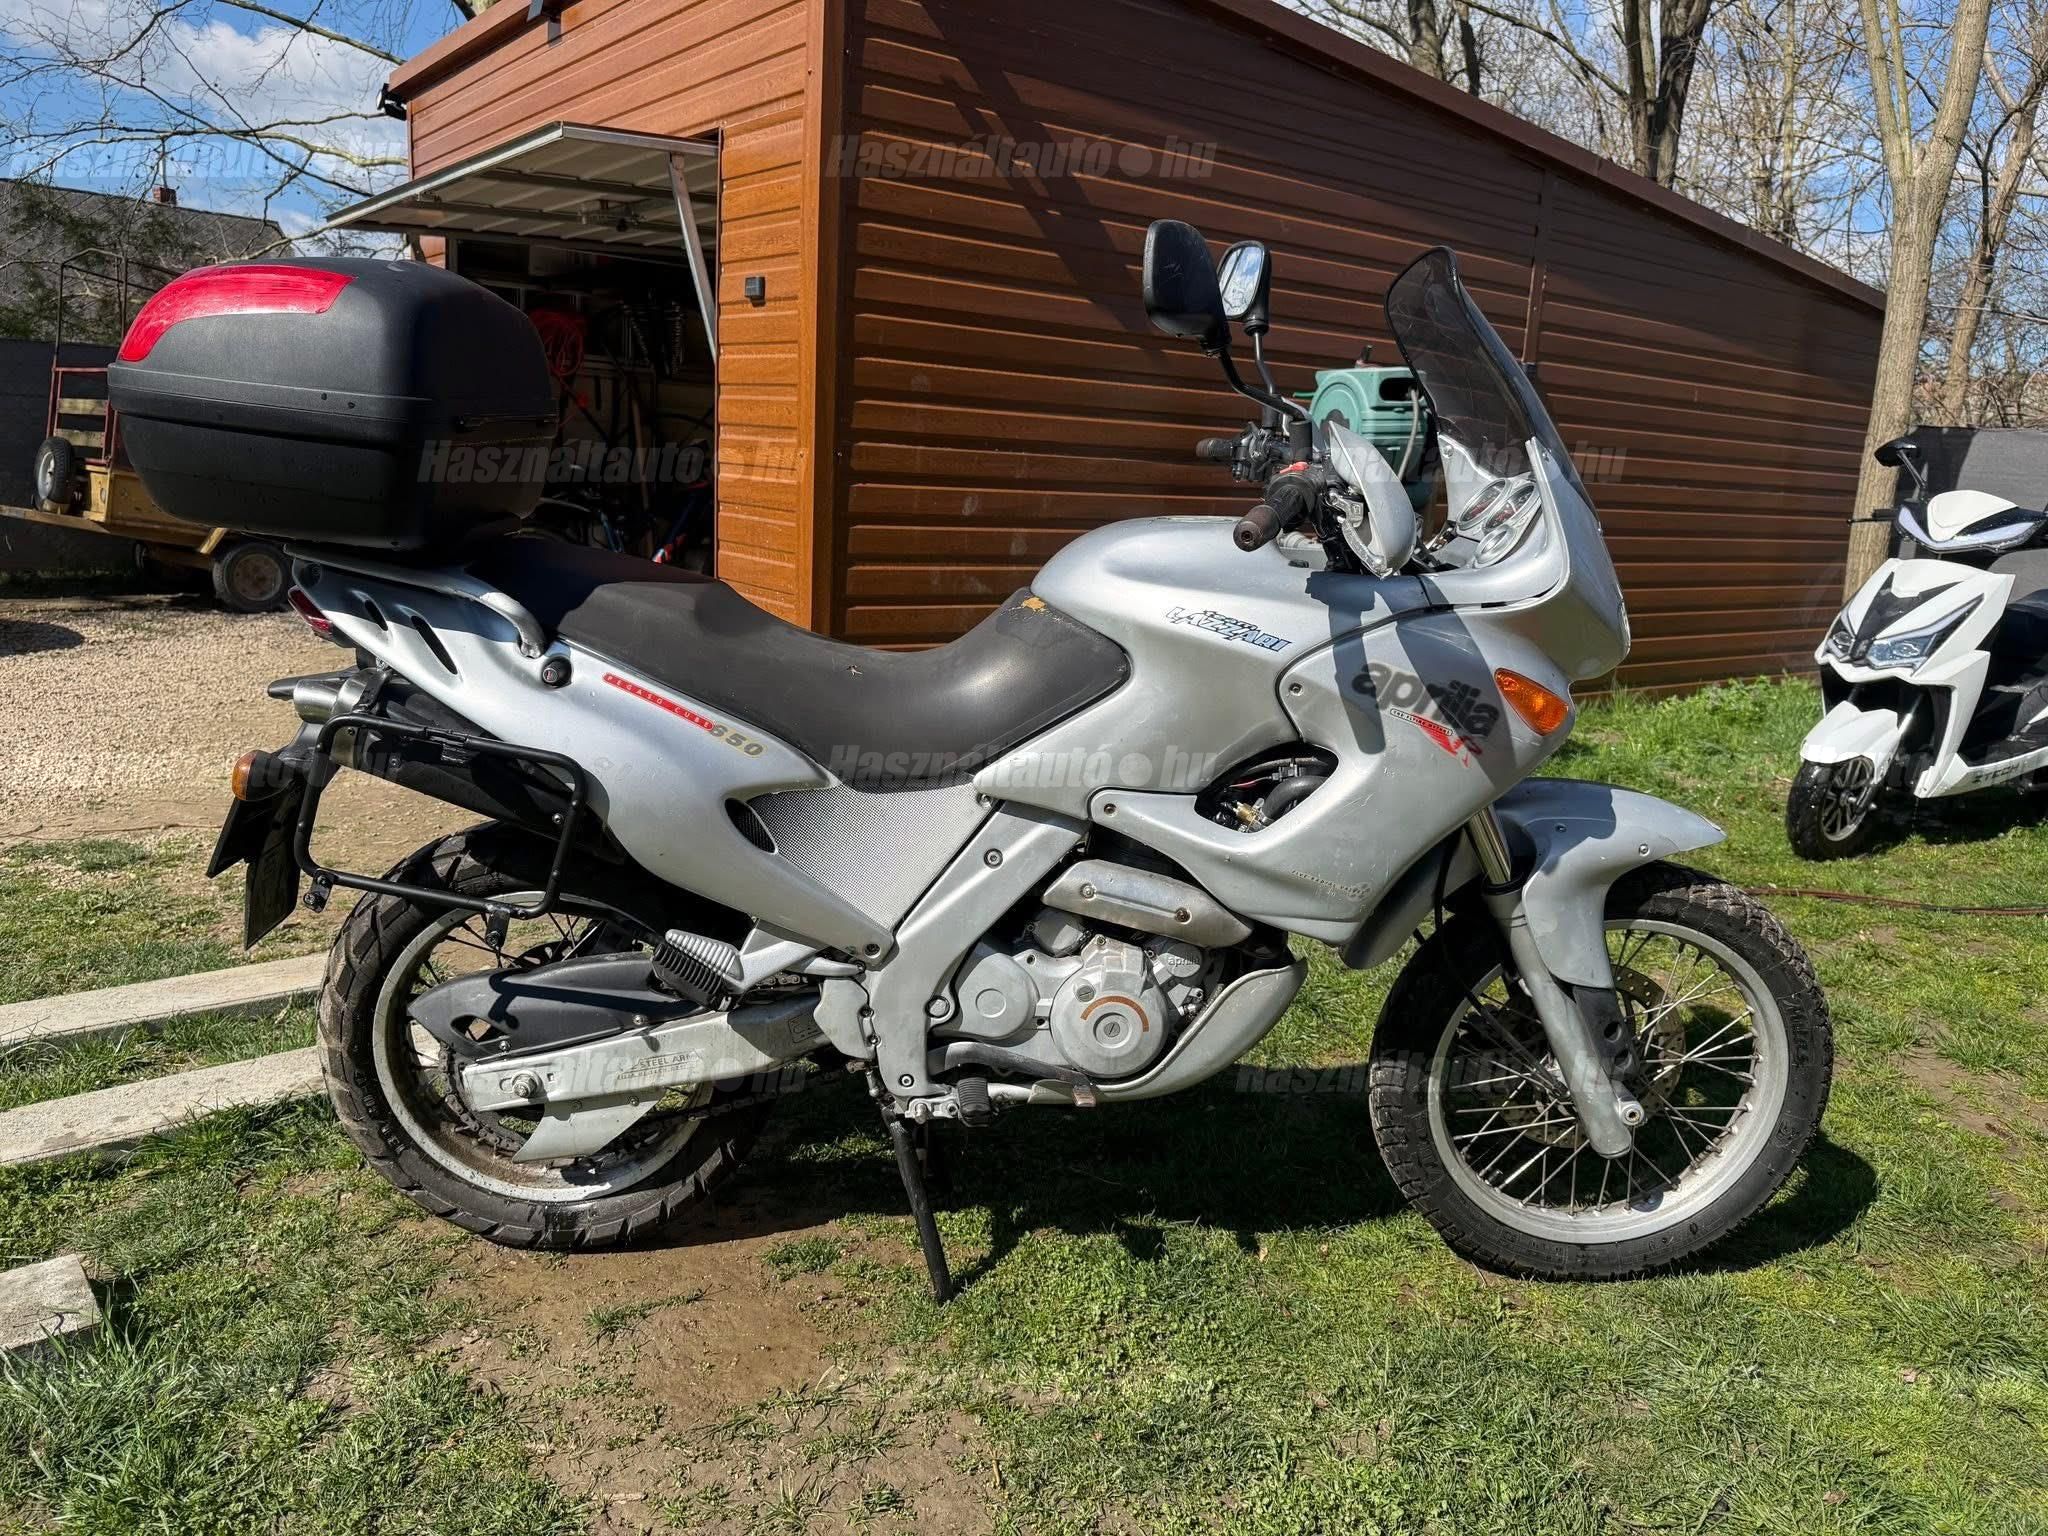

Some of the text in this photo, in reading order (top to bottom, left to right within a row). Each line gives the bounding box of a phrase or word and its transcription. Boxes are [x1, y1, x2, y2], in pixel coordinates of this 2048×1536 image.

[606, 675, 710, 728] PEGASO CUBE
[1351, 662, 1500, 737] aprilia
[711, 724, 765, 756] 650
[1167, 951, 1200, 968] aprilia
[640, 1056, 669, 1068] STEEL
